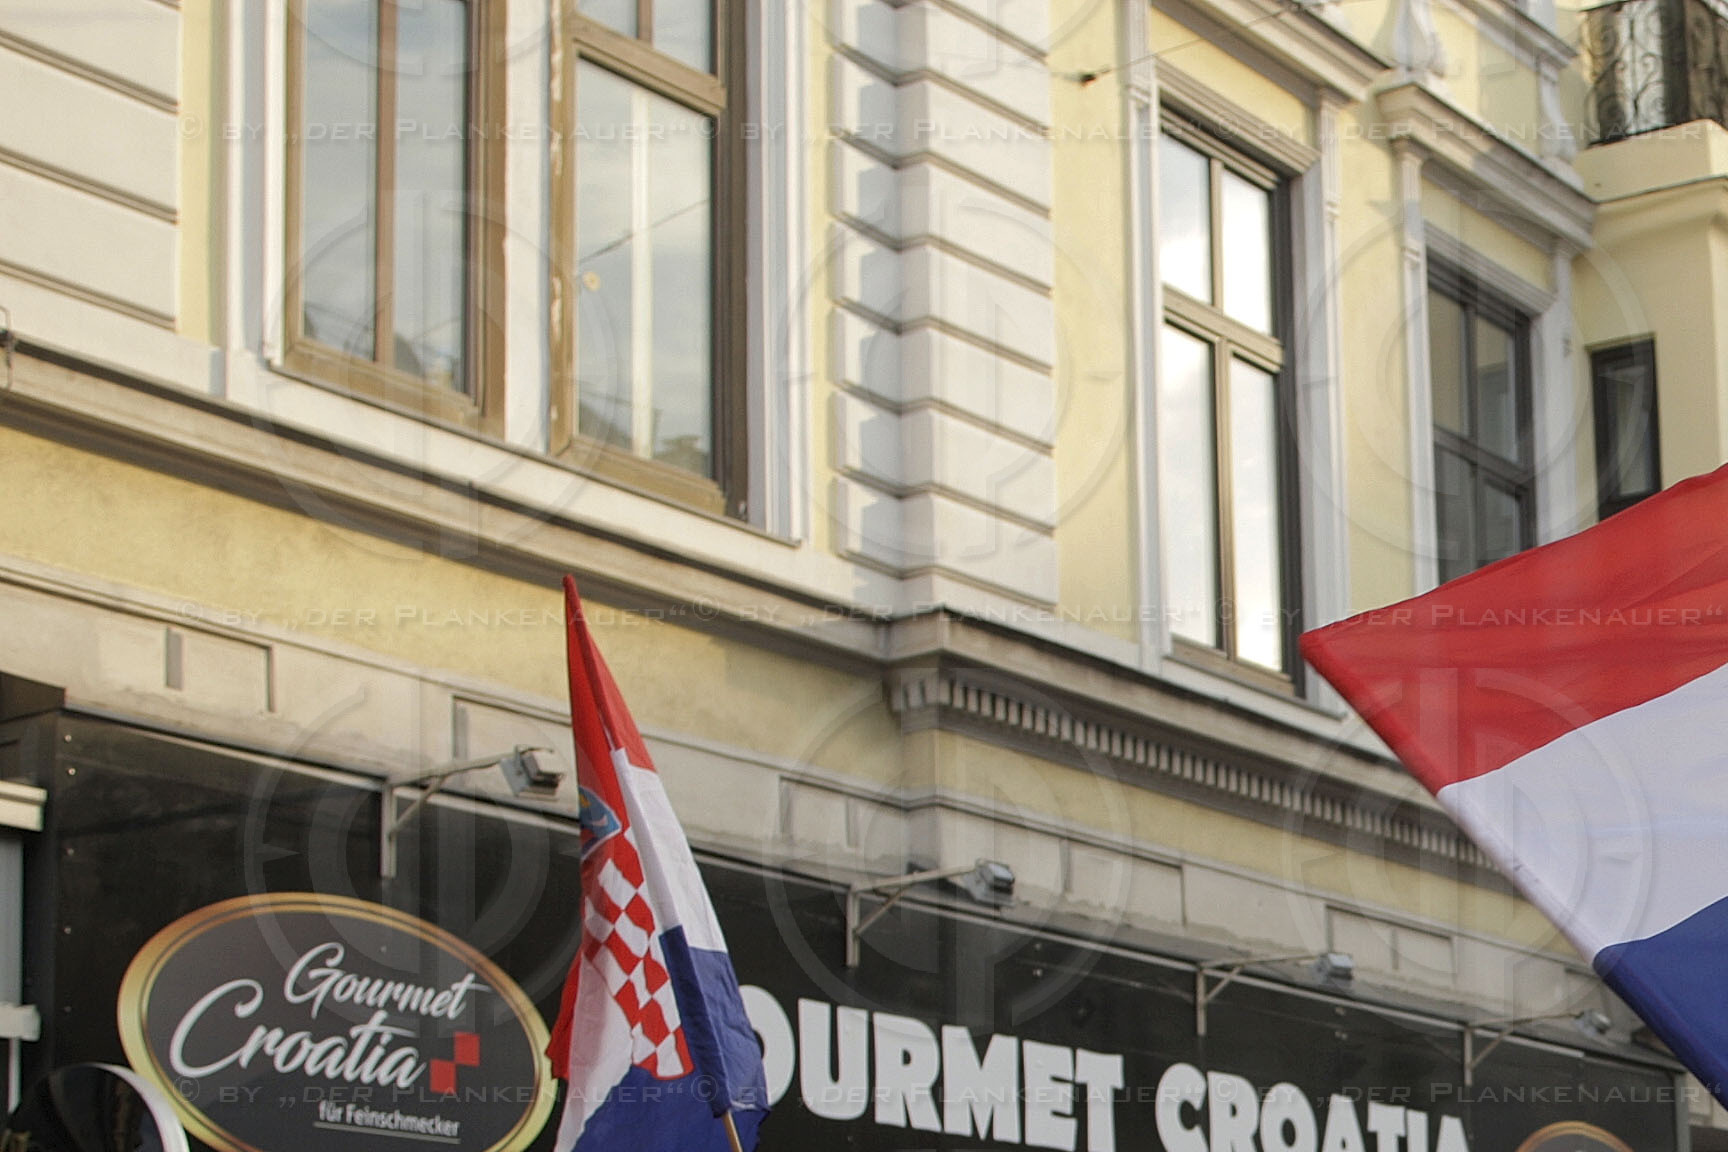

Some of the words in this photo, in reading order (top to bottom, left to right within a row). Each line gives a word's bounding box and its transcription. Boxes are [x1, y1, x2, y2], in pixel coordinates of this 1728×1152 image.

[284, 942, 493, 1019] Gourmet
[169, 978, 427, 1089] Croatia
[318, 1099, 343, 1122] für
[345, 1104, 461, 1138] Feinschmecker
